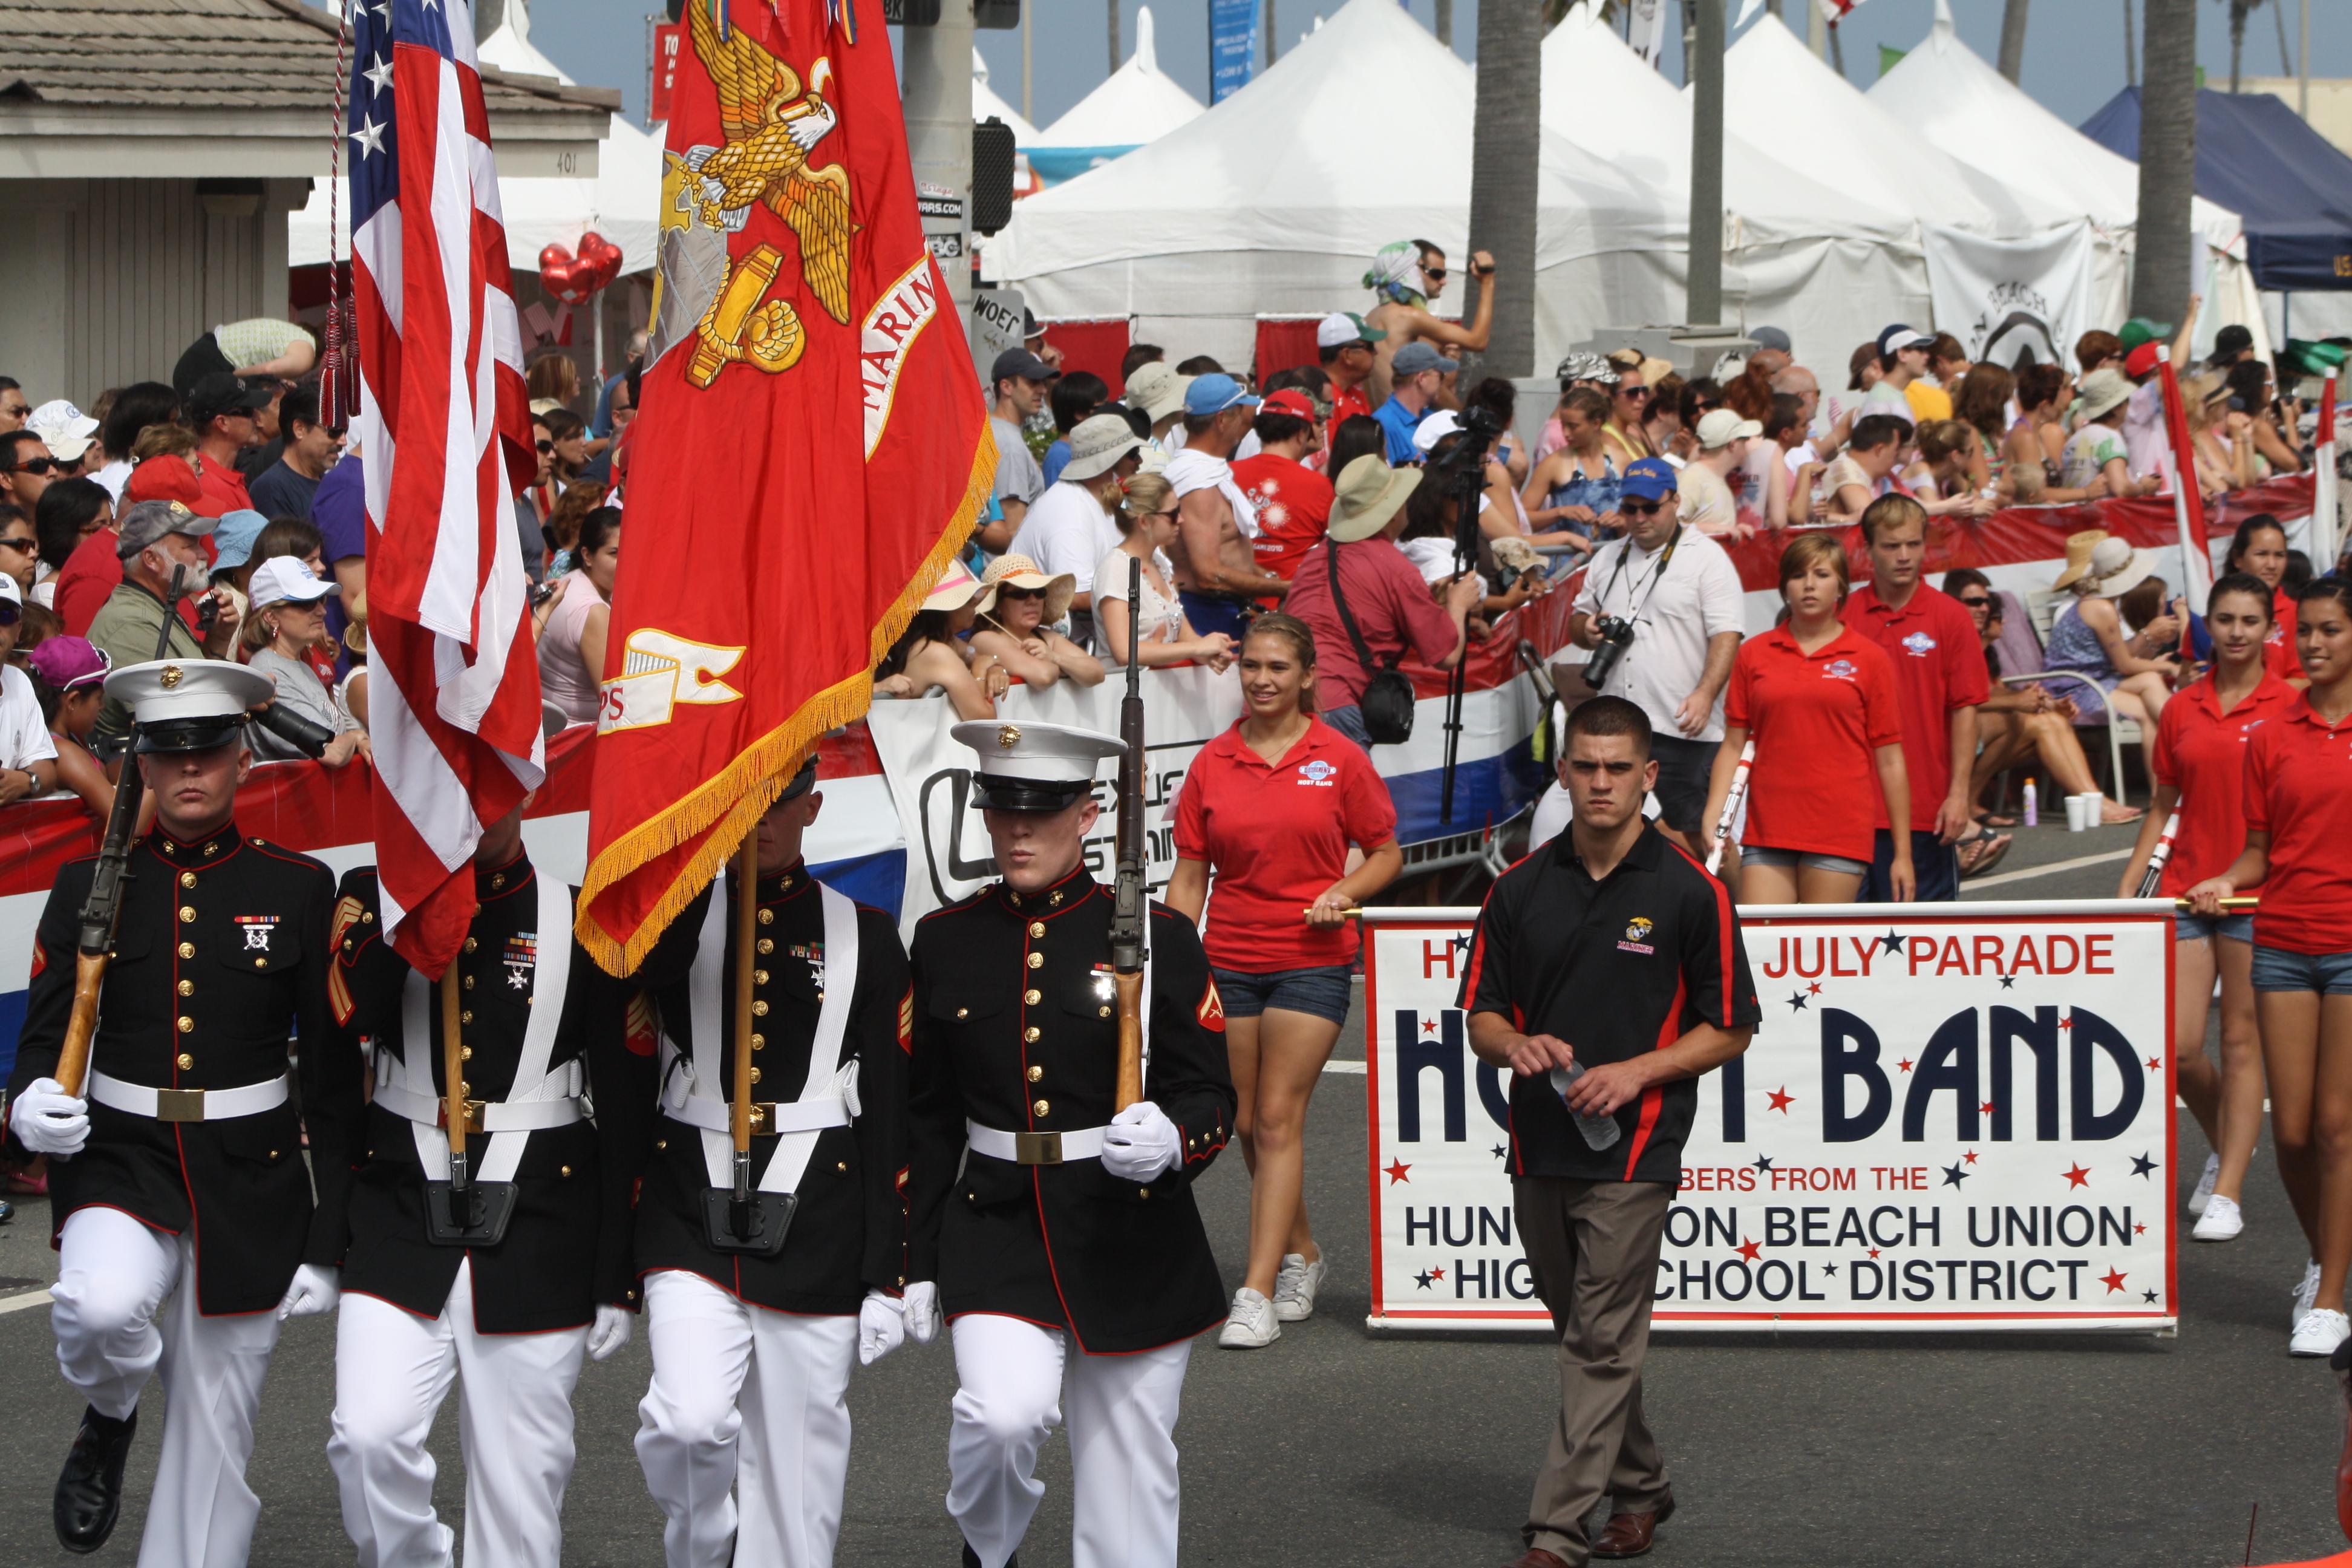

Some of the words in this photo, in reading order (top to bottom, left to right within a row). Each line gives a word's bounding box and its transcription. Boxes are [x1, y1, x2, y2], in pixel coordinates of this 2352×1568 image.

[557, 152, 576, 175] 401
[1987, 281, 2047, 316] BEACH
[1616, 940, 1655, 955] MARINES
[1763, 936, 1881, 978] JULY
[1908, 934, 2114, 976] PARADE
[1820, 1005, 2145, 1143] BAND
[1771, 1167, 1855, 1191] FROM
[1870, 1167, 1928, 1190] THE
[1764, 1206, 1941, 1247] BEACH
[1967, 1205, 2132, 1248] UNION
[1849, 1259, 2089, 1302] DISTRICT
